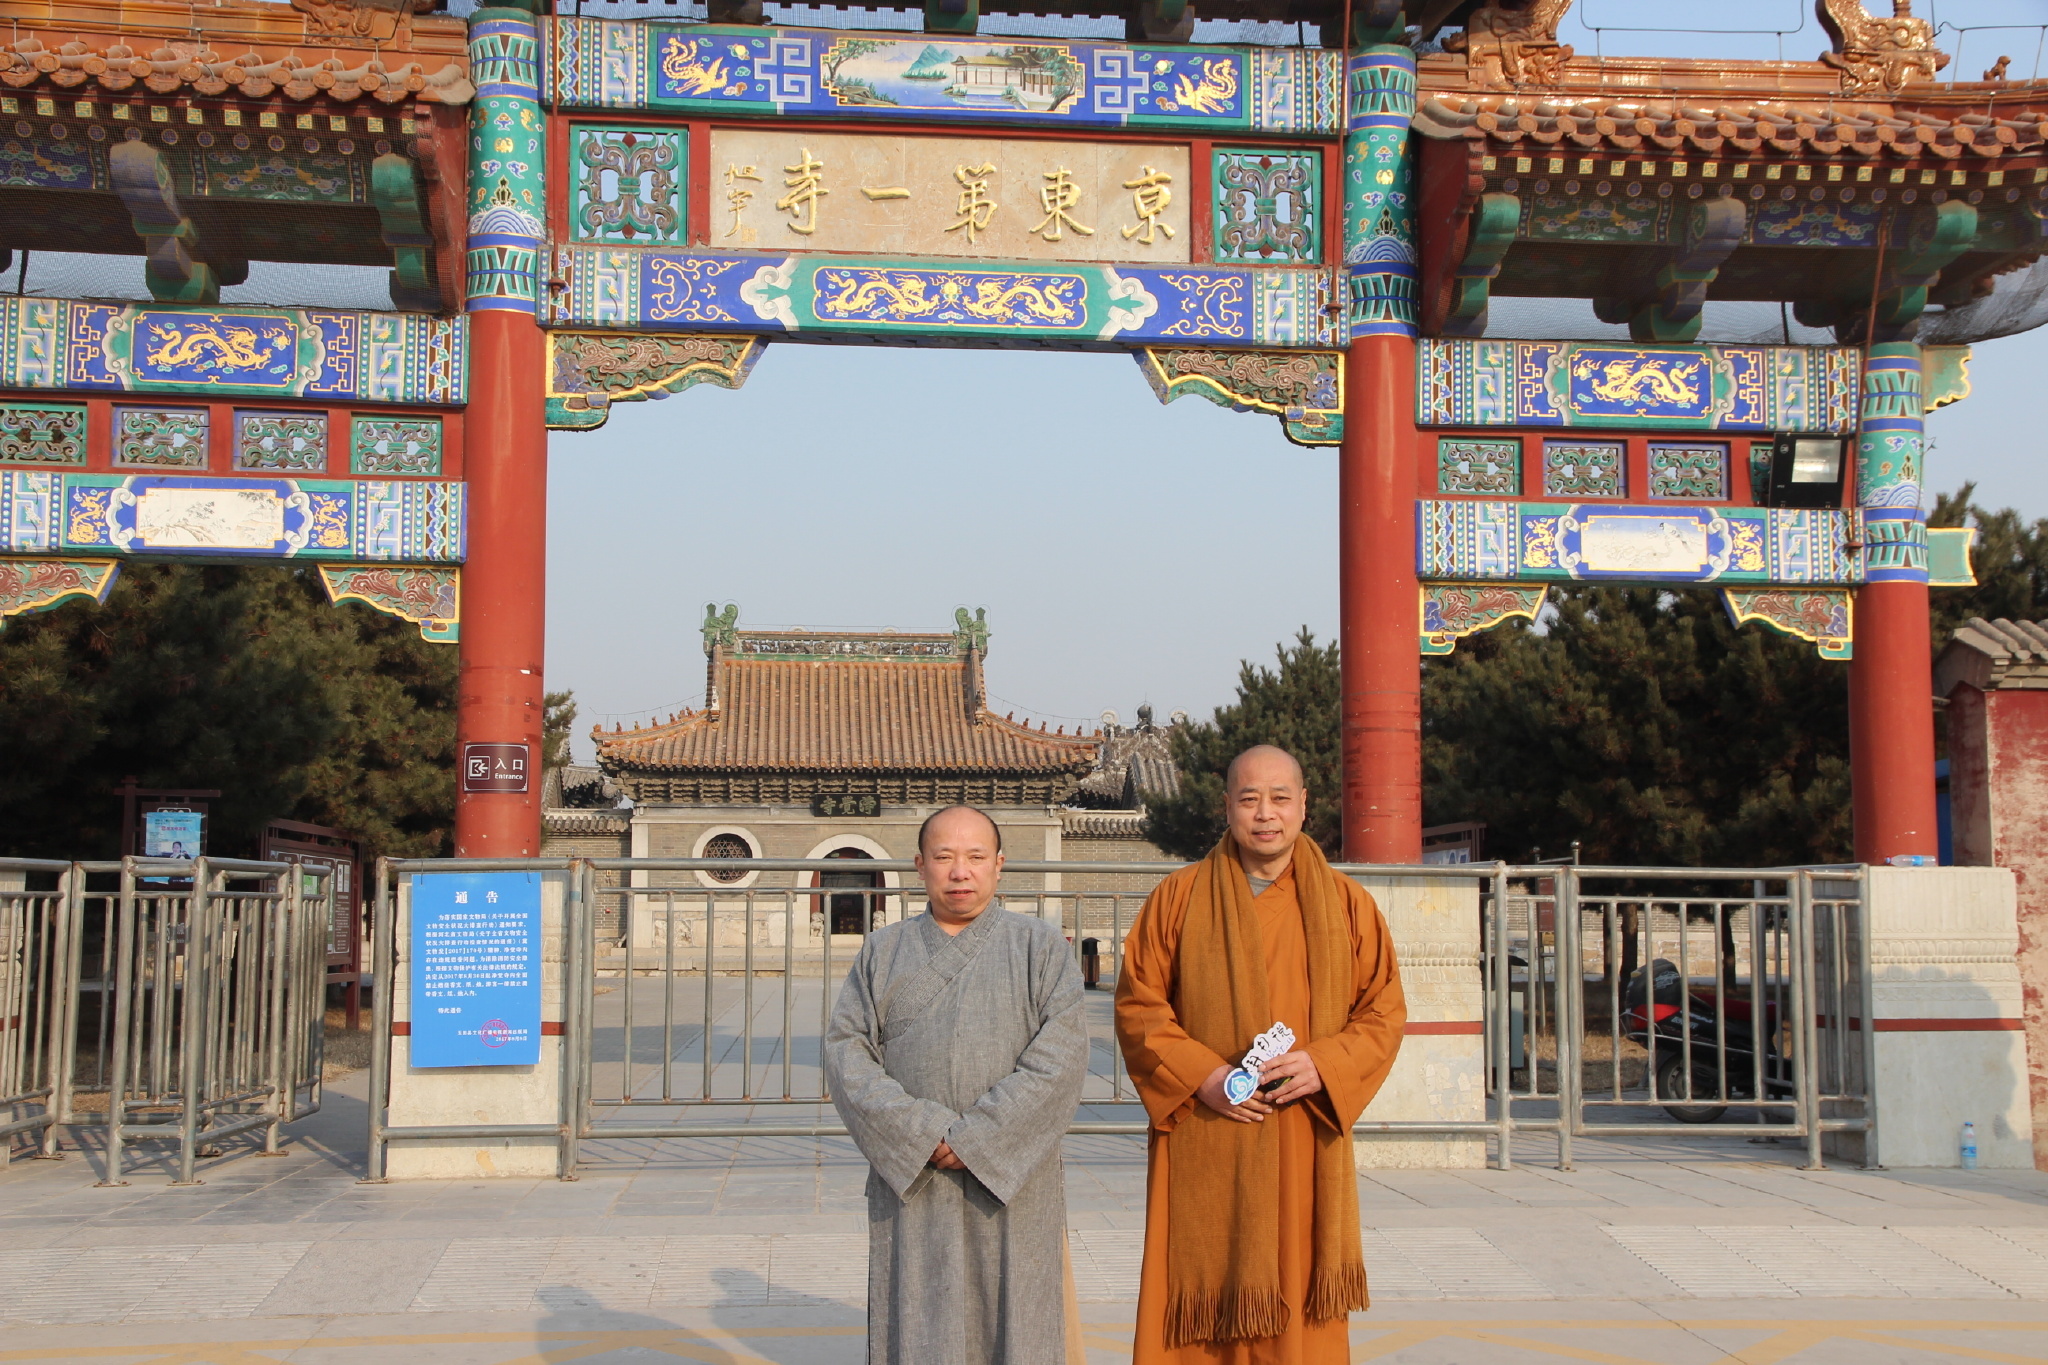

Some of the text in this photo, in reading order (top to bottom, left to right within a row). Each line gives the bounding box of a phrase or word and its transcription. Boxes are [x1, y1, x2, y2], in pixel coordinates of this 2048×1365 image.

[494, 757, 523, 770] 入口
[494, 772, 523, 780] Entrance
[455, 890, 499, 904] 通告
